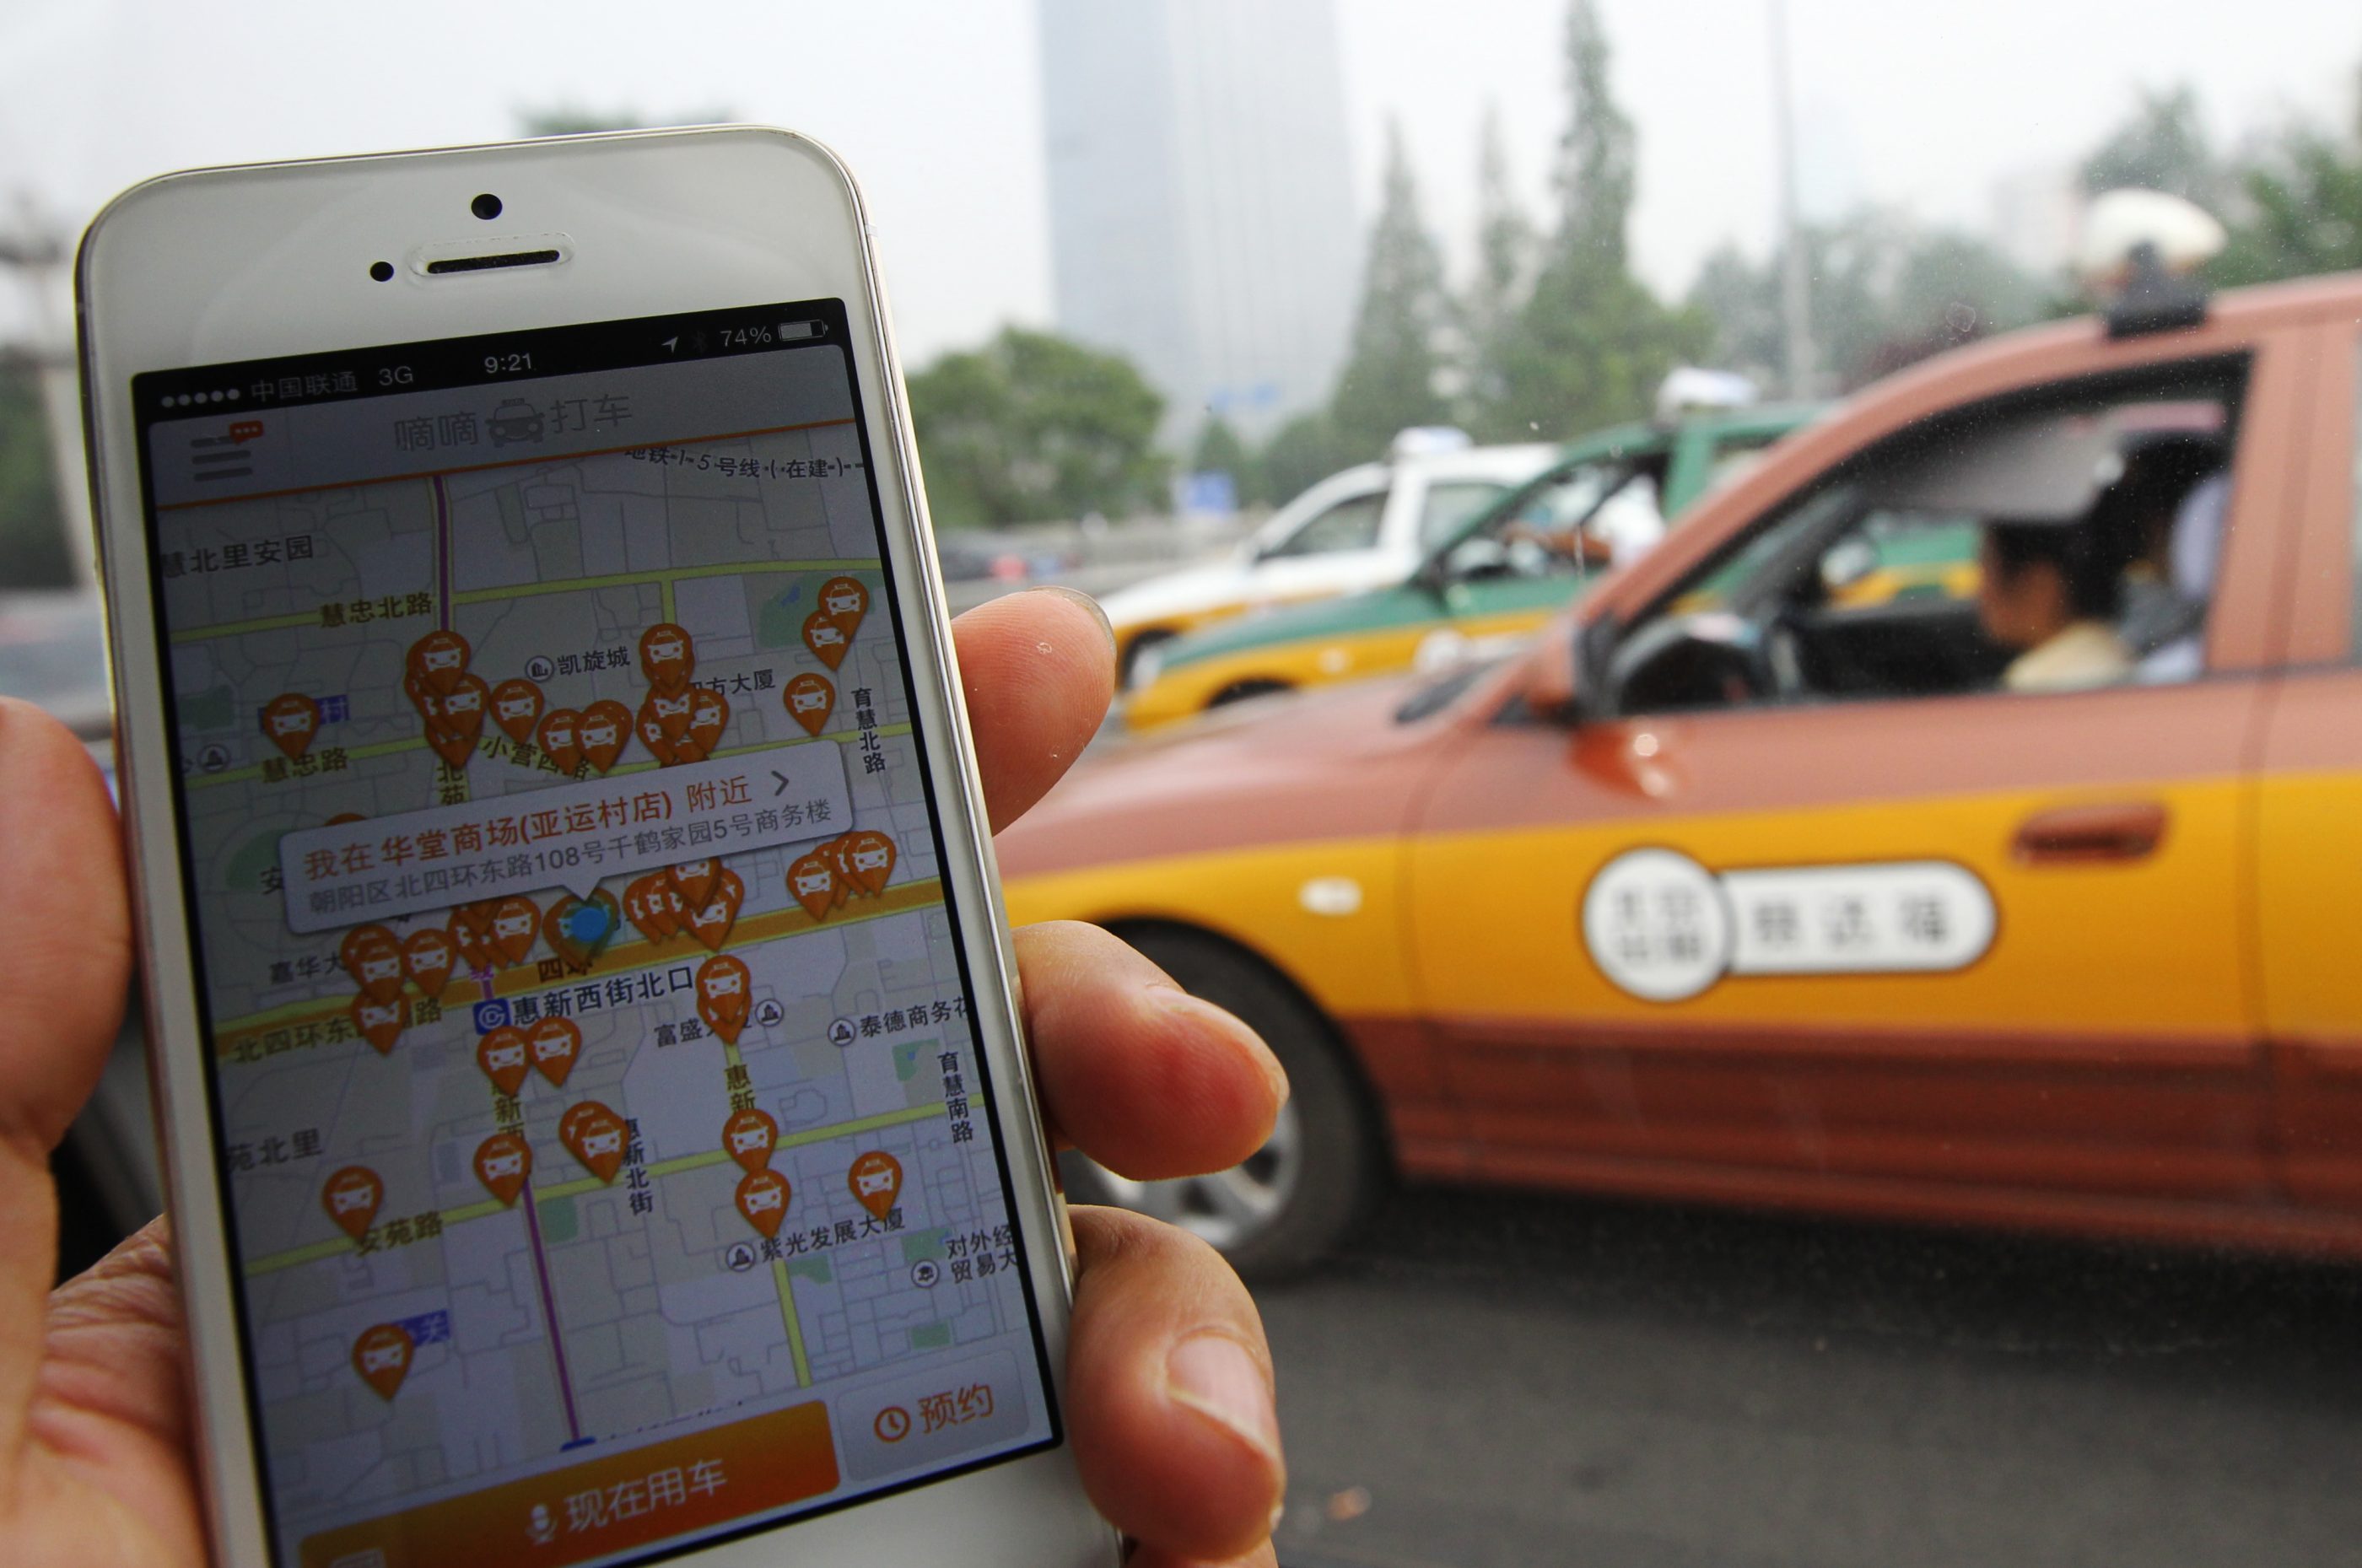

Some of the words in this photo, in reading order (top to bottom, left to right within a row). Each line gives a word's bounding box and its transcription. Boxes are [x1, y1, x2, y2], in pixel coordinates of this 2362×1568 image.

[720, 326, 773, 348] 74%
[251, 372, 358, 402] 中国联通
[378, 364, 414, 387] 3G
[484, 352, 533, 374] 9:21
[551, 394, 633, 434] 打车
[320, 592, 433, 628] 慧忠北路
[557, 646, 631, 676] 凯旋城
[851, 687, 887, 774] 育慧北路
[687, 775, 752, 813] 附近
[512, 967, 693, 1026] 惠新西街北口
[937, 1051, 973, 1144] 育慧南路
[357, 1211, 444, 1257] 安苑路
[759, 1208, 905, 1264] 紫光发展大厦
[918, 1383, 994, 1434] 预约
[563, 1458, 727, 1533] 现在用车
